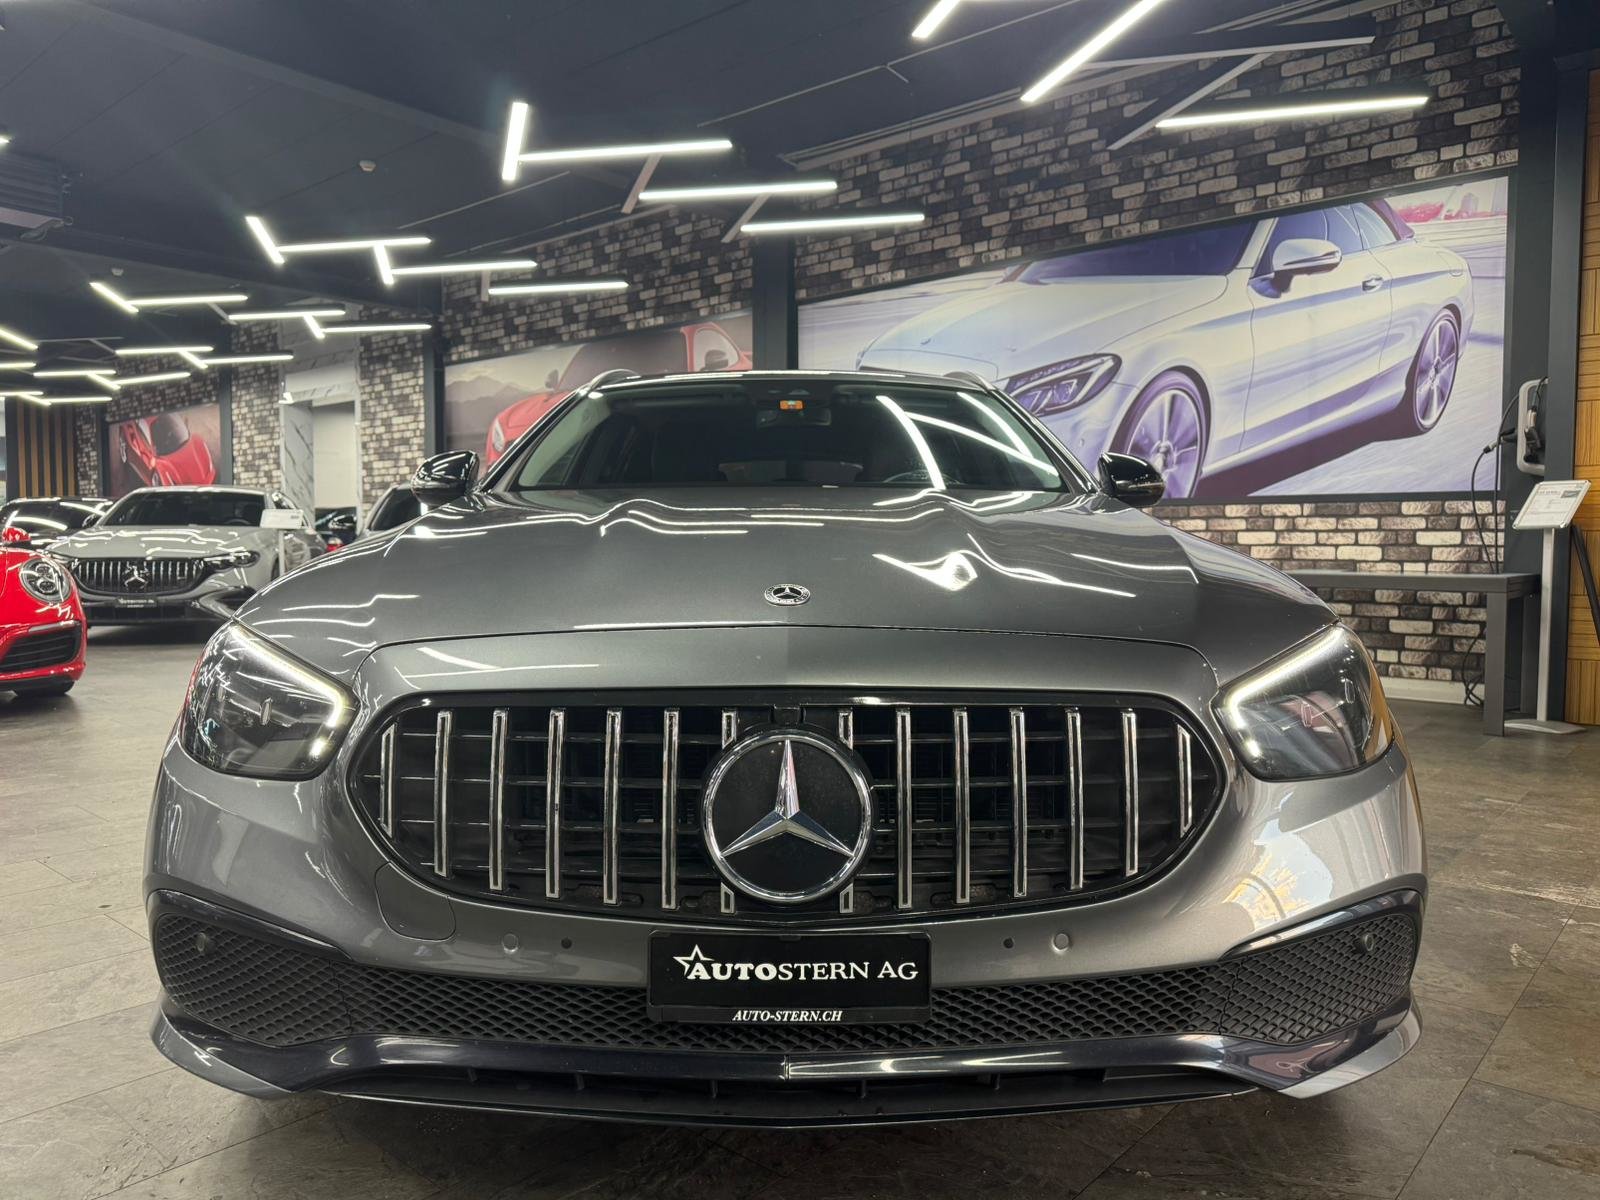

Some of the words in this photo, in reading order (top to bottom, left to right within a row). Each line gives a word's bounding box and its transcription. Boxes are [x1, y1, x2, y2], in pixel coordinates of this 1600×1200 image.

[686, 961, 870, 981] AUTOSTERN
[877, 960, 919, 980] AG
[732, 1010, 843, 1022] AUTO-STERN.CH
